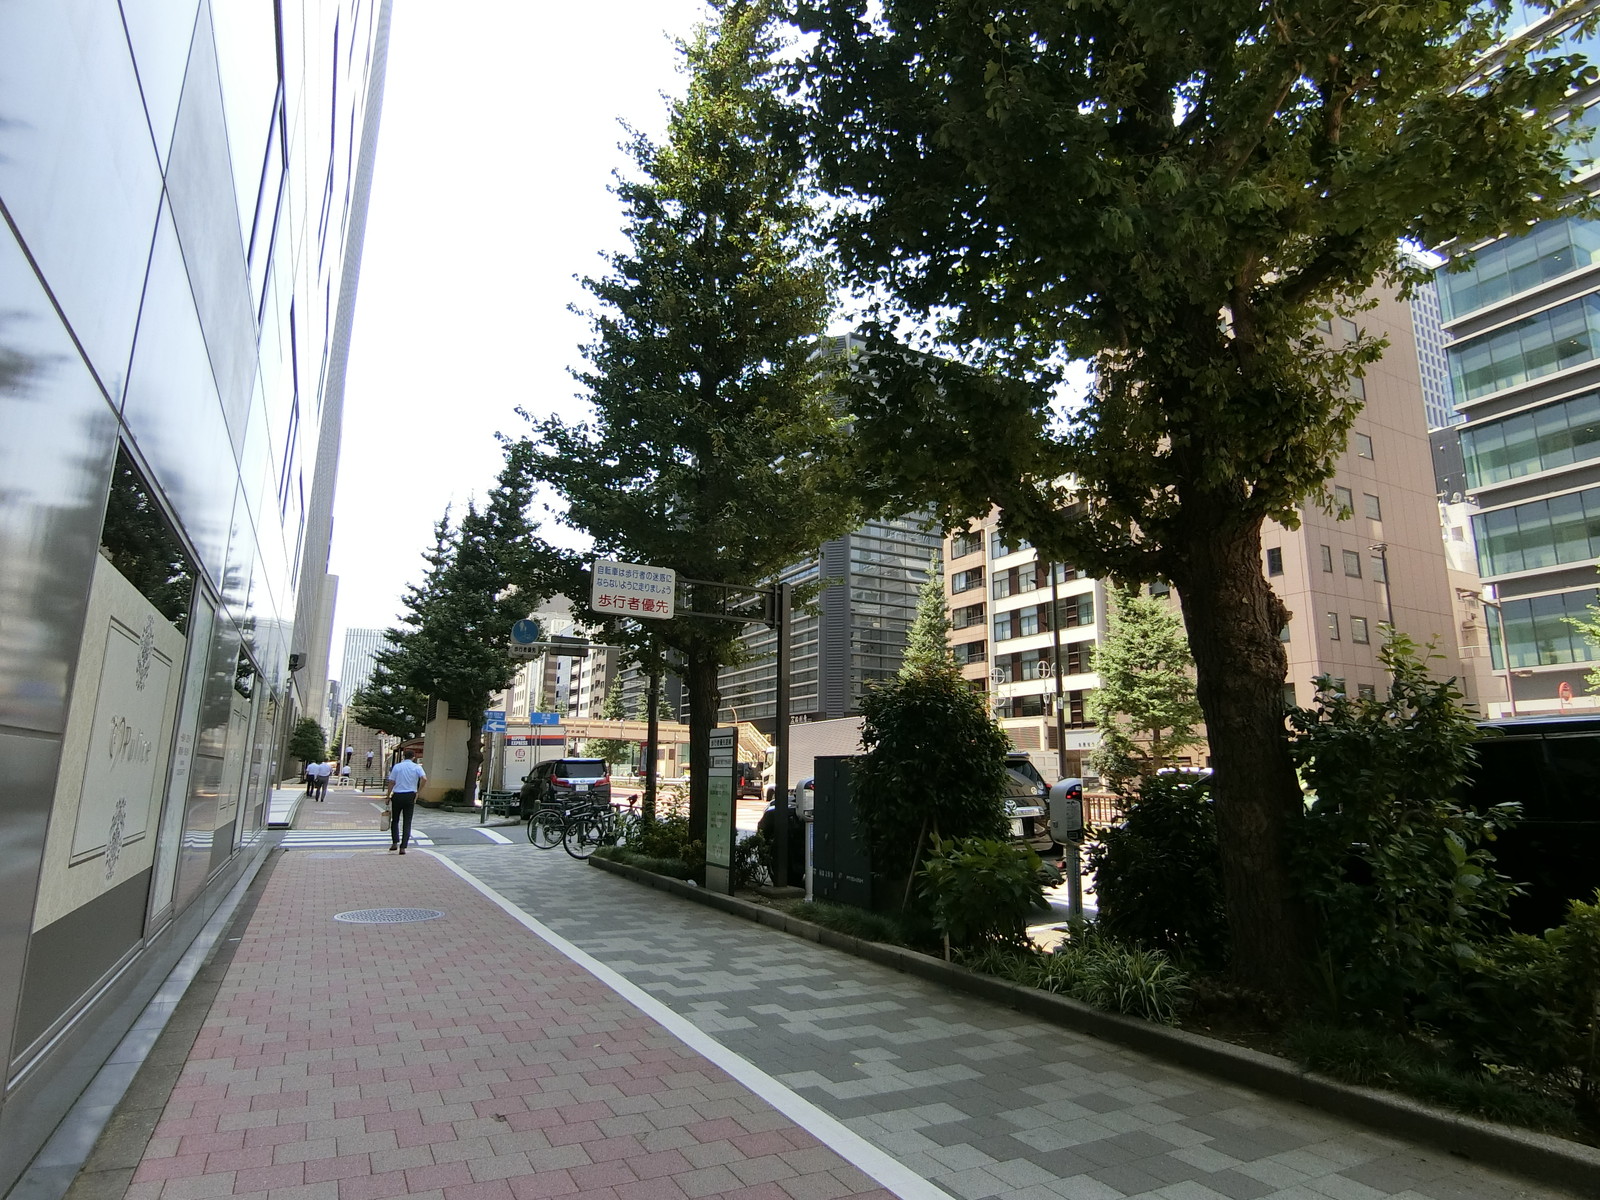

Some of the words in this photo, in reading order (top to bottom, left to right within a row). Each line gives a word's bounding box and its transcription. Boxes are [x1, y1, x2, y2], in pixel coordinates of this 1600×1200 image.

[597, 565, 672, 583] 自転車は歩行者の迷惑に
[596, 578, 672, 595] ならないように走りましょう
[598, 594, 669, 614] 歩行者優先
